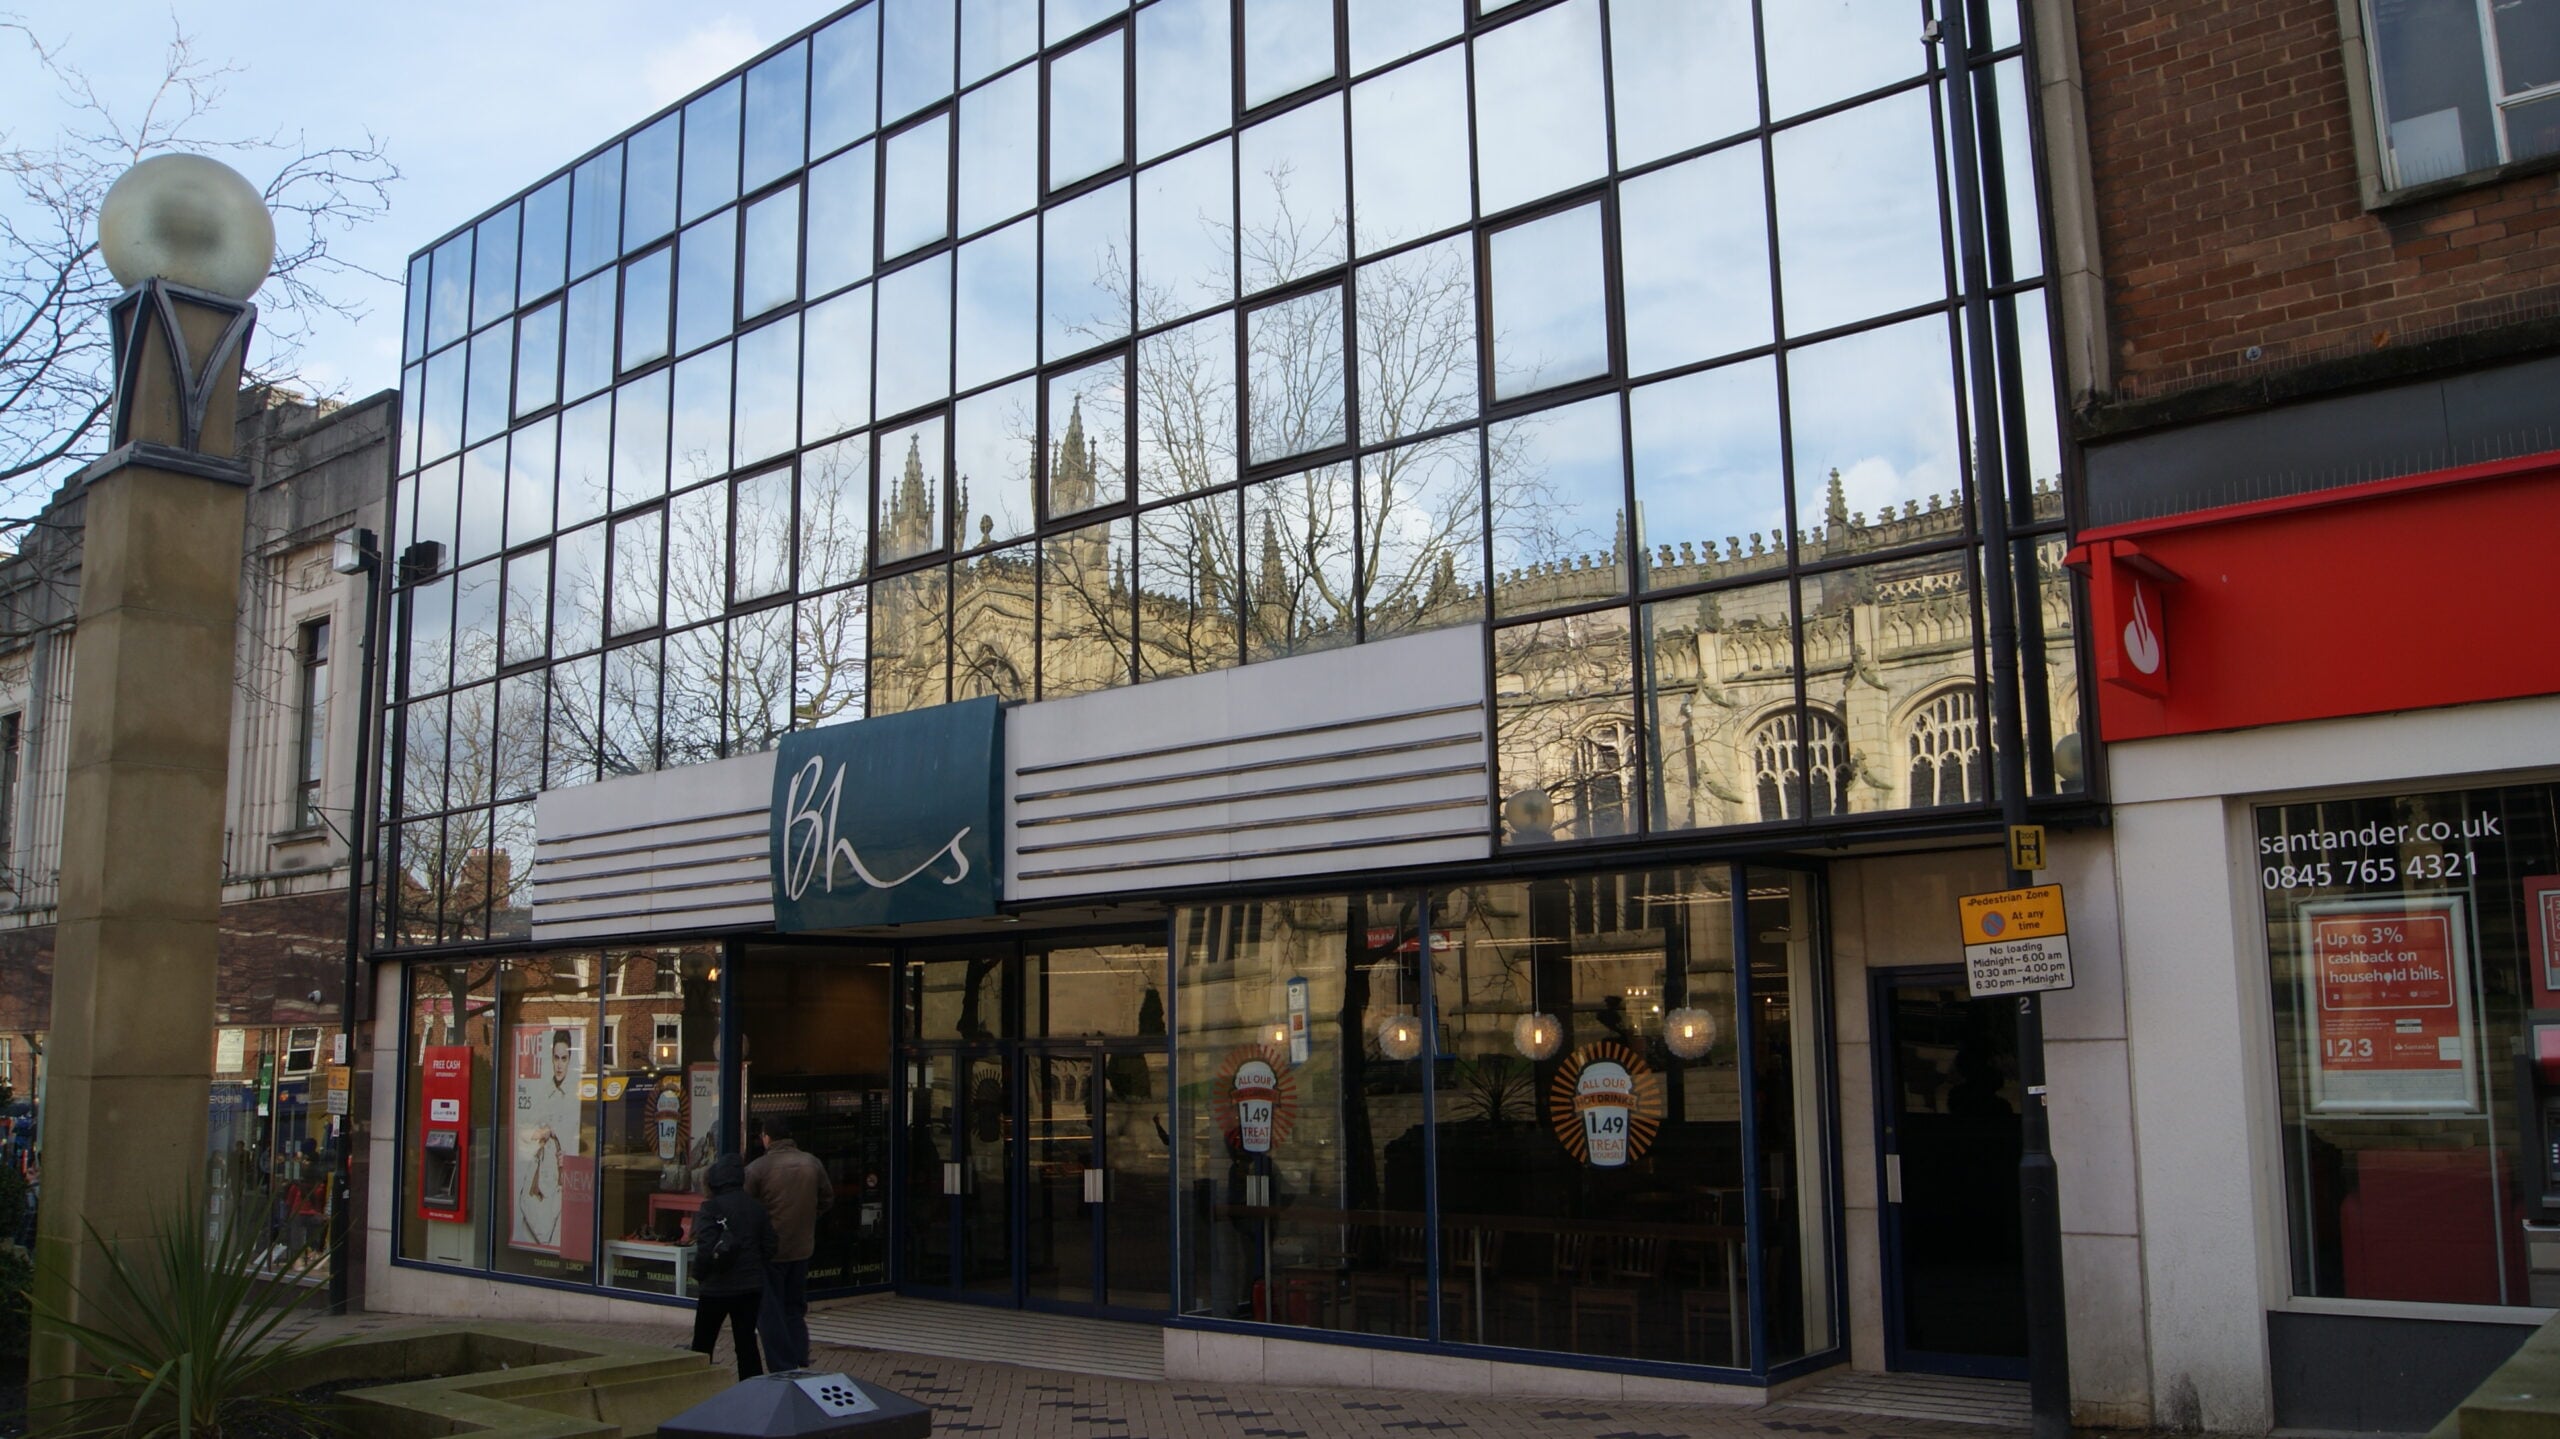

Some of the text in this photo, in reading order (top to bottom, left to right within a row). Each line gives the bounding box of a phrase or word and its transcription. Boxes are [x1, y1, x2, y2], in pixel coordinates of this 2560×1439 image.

[783, 754, 971, 901] Bhs
[2259, 811, 2502, 854] santander.co.uk
[2263, 851, 2477, 890] 0845 765 4321
[1970, 890, 2050, 906] Pedestrian Zone
[2012, 911, 2044, 920] At any
[2018, 921, 2041, 931] time
[2327, 926, 2403, 948] Up to 3%
[1990, 943, 2043, 955] No loading
[2048, 952, 2062, 960] am
[2328, 949, 2417, 964] cashback on
[1973, 969, 2000, 979] 10.30
[2050, 963, 2065, 972] pm
[2330, 966, 2444, 985] household bills.
[1975, 979, 1998, 990] 6.30
[2019, 996, 2031, 1014] 2
[2403, 1043, 2435, 1051] Santander
[432, 1060, 461, 1070] FREE CASH
[1253, 1075, 1272, 1086] OUR
[1583, 1078, 1626, 1090] ALL OUR
[518, 1096, 532, 1110] £25
[1597, 1094, 1634, 1106] DRINKS
[1242, 1102, 1269, 1123] 1.49
[1588, 1111, 1624, 1134] 1.49
[660, 1122, 675, 1138] 1.49
[1244, 1127, 1269, 1138] TREAT
[1590, 1139, 1625, 1151] TREAT
[806, 1267, 842, 1278] KEAWAY
